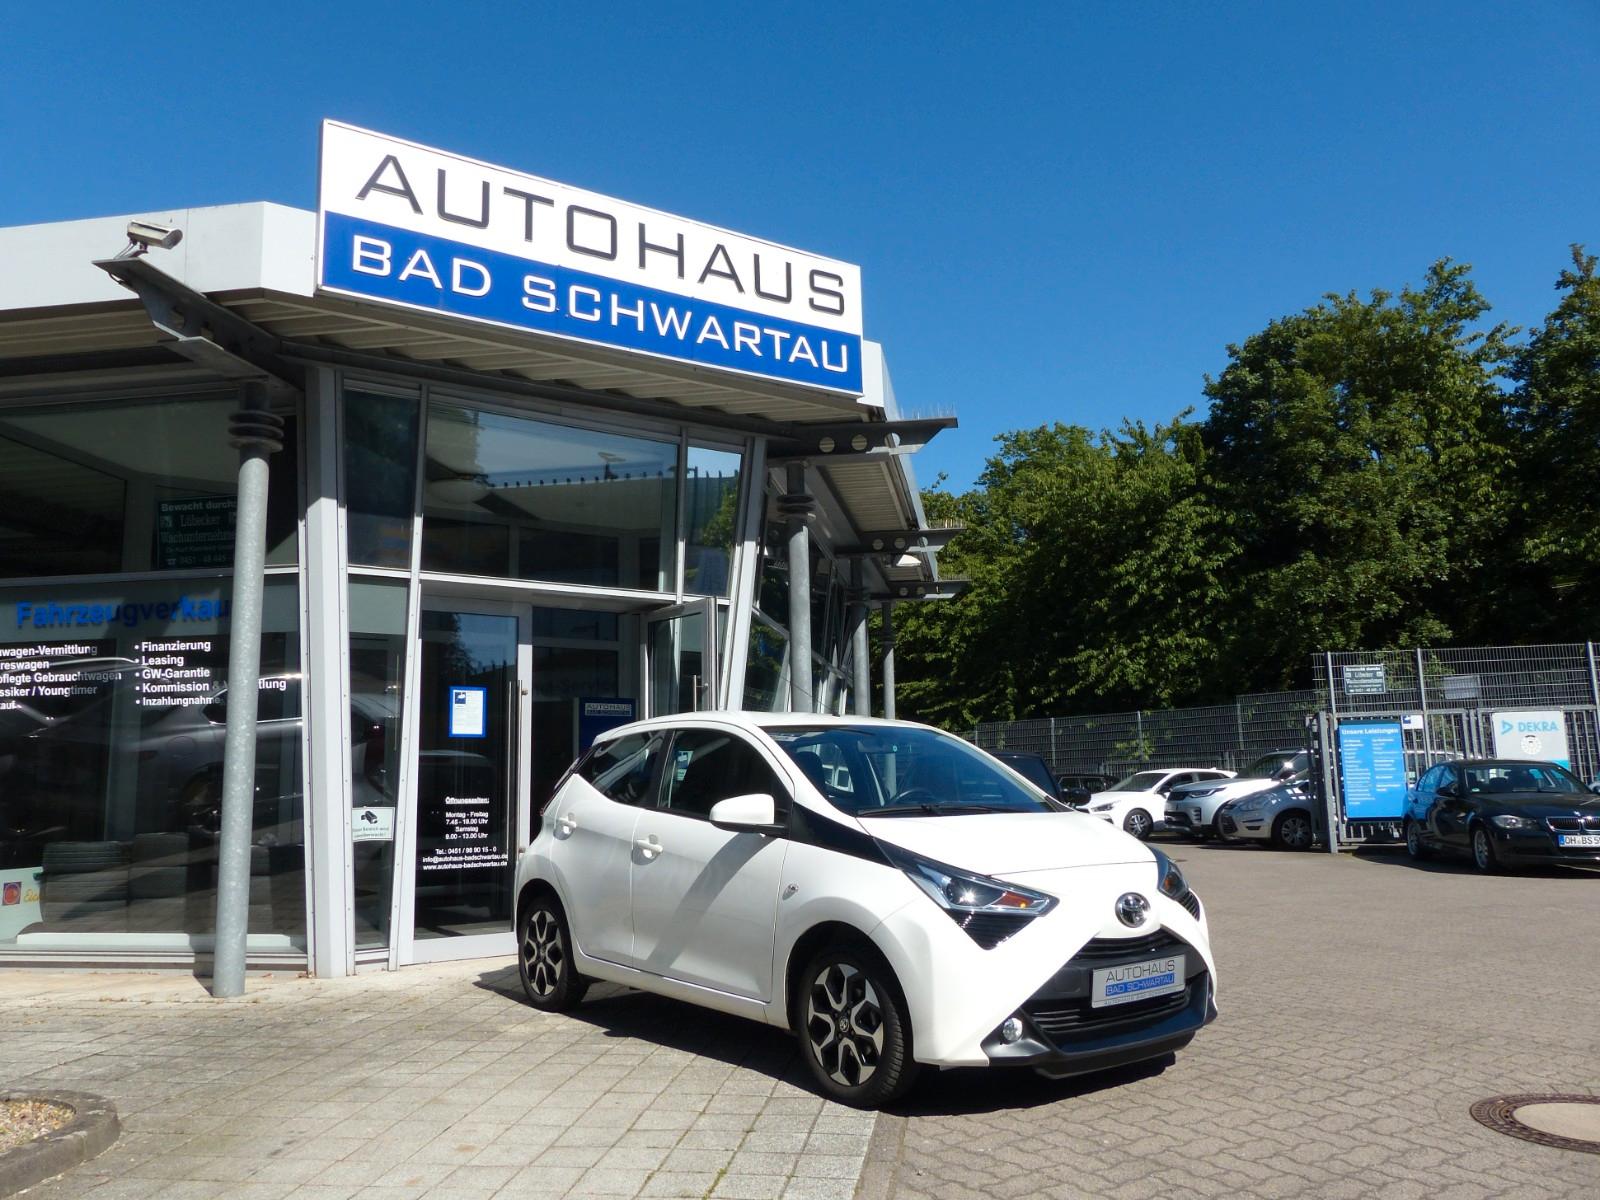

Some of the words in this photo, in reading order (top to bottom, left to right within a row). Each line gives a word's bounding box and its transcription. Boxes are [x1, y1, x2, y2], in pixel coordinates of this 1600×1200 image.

[356, 153, 845, 317] AUTOHAUS
[351, 233, 493, 299] BAD
[521, 273, 849, 374] SCHWARTAU
[161, 501, 204, 512] Bewacht
[16, 596, 231, 627] Fahrzeugverkau
[141, 640, 211, 652] Finanzierung
[141, 655, 184, 666] Leasing
[34, 670, 121, 682] Gebrauchtwagen
[142, 667, 210, 679] GW-Garantie
[38, 685, 97, 697] Youngtimer
[142, 682, 209, 693] Kommission
[143, 695, 221, 706] Inzahlungnahme
[1518, 722, 1558, 732] DEKRA
[1106, 960, 1175, 982] AUTOHAUS
[1106, 984, 1124, 995] BAD
[1126, 974, 1174, 991] SCHWARTAU
